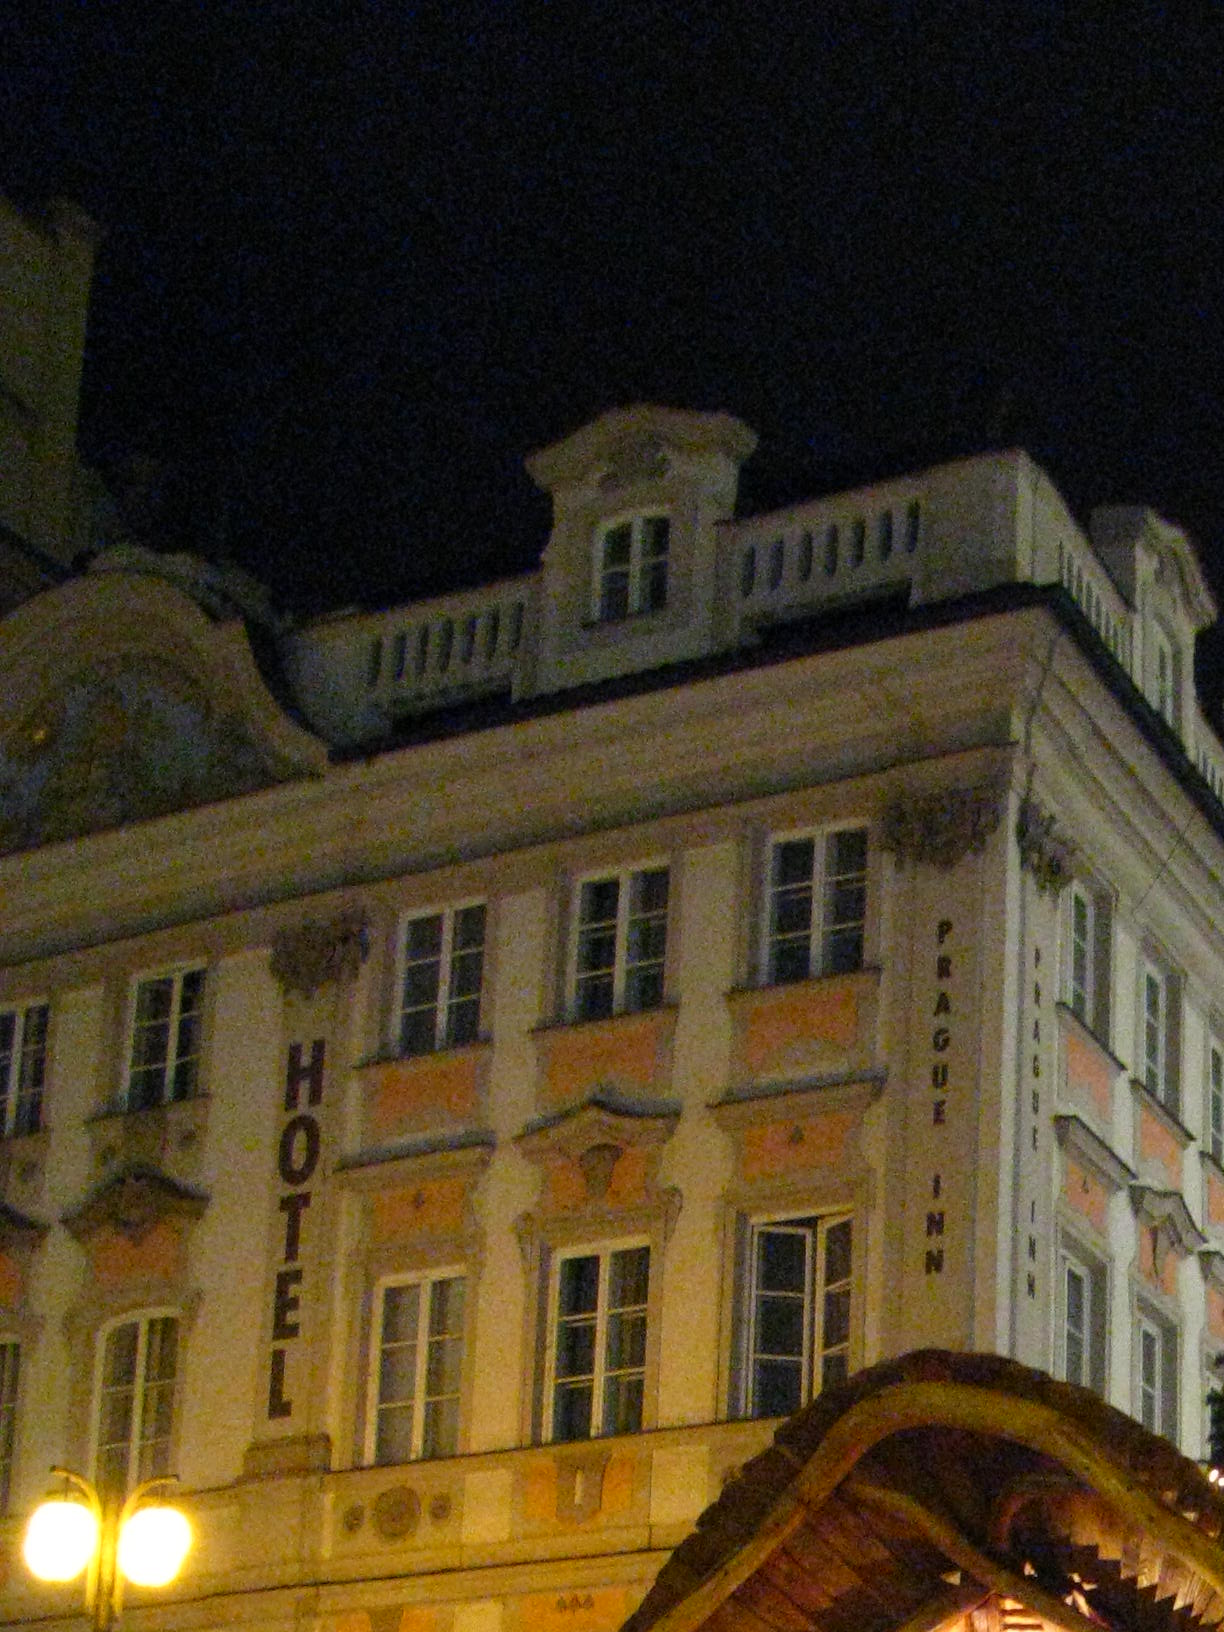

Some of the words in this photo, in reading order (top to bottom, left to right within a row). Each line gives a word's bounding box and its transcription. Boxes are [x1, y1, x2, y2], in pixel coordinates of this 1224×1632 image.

[931, 919, 952, 1126] PRAGUE
[1031, 946, 1042, 1153] PRAGUE
[267, 1038, 326, 1420] HOTEL
[925, 1173, 945, 1276] INN
[1026, 1200, 1037, 1301] INN
